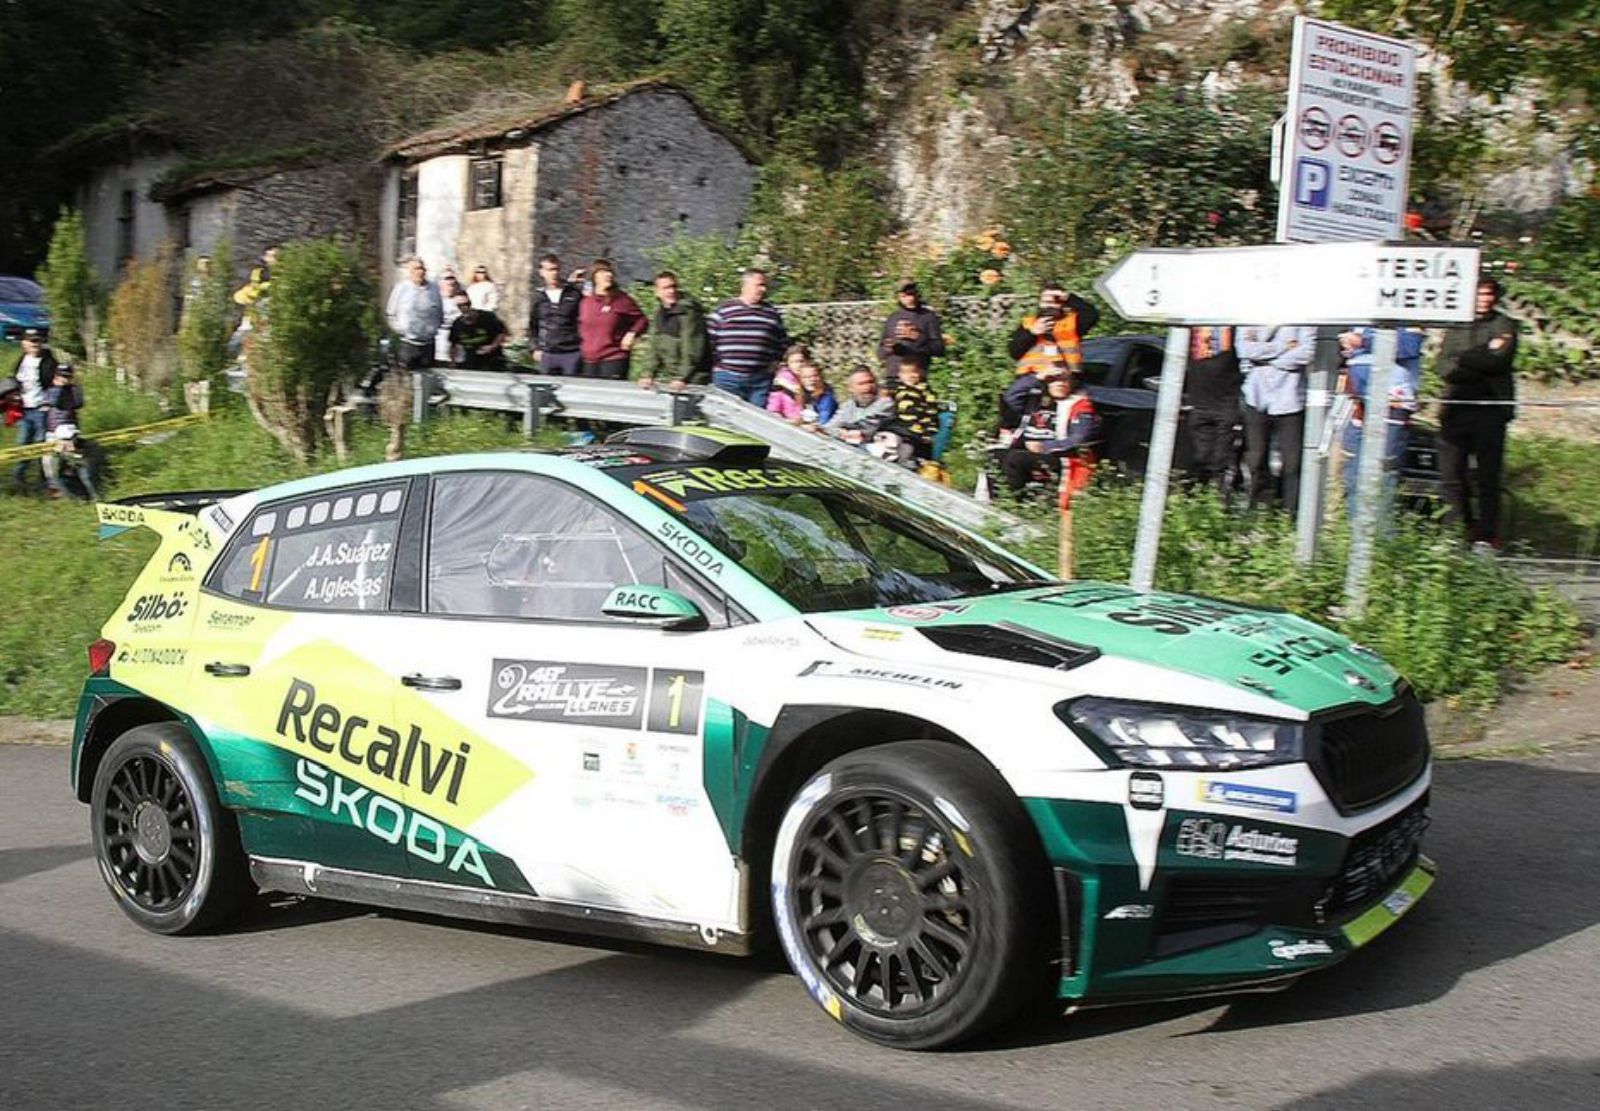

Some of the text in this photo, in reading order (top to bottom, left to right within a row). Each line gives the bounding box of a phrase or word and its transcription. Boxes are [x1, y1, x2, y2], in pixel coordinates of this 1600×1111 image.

[1316, 36, 1401, 67] PROHIBIDO
[1308, 54, 1405, 87] ESTACIONAR
[1299, 162, 1327, 203] P
[1378, 283, 1459, 309] MERÉ
[614, 590, 661, 611] RACC
[516, 679, 610, 703] RALLYE
[850, 667, 963, 690] MICHELIN
[567, 700, 632, 713] LLANES
[667, 674, 687, 727] 1
[276, 677, 471, 805] Recalvi
